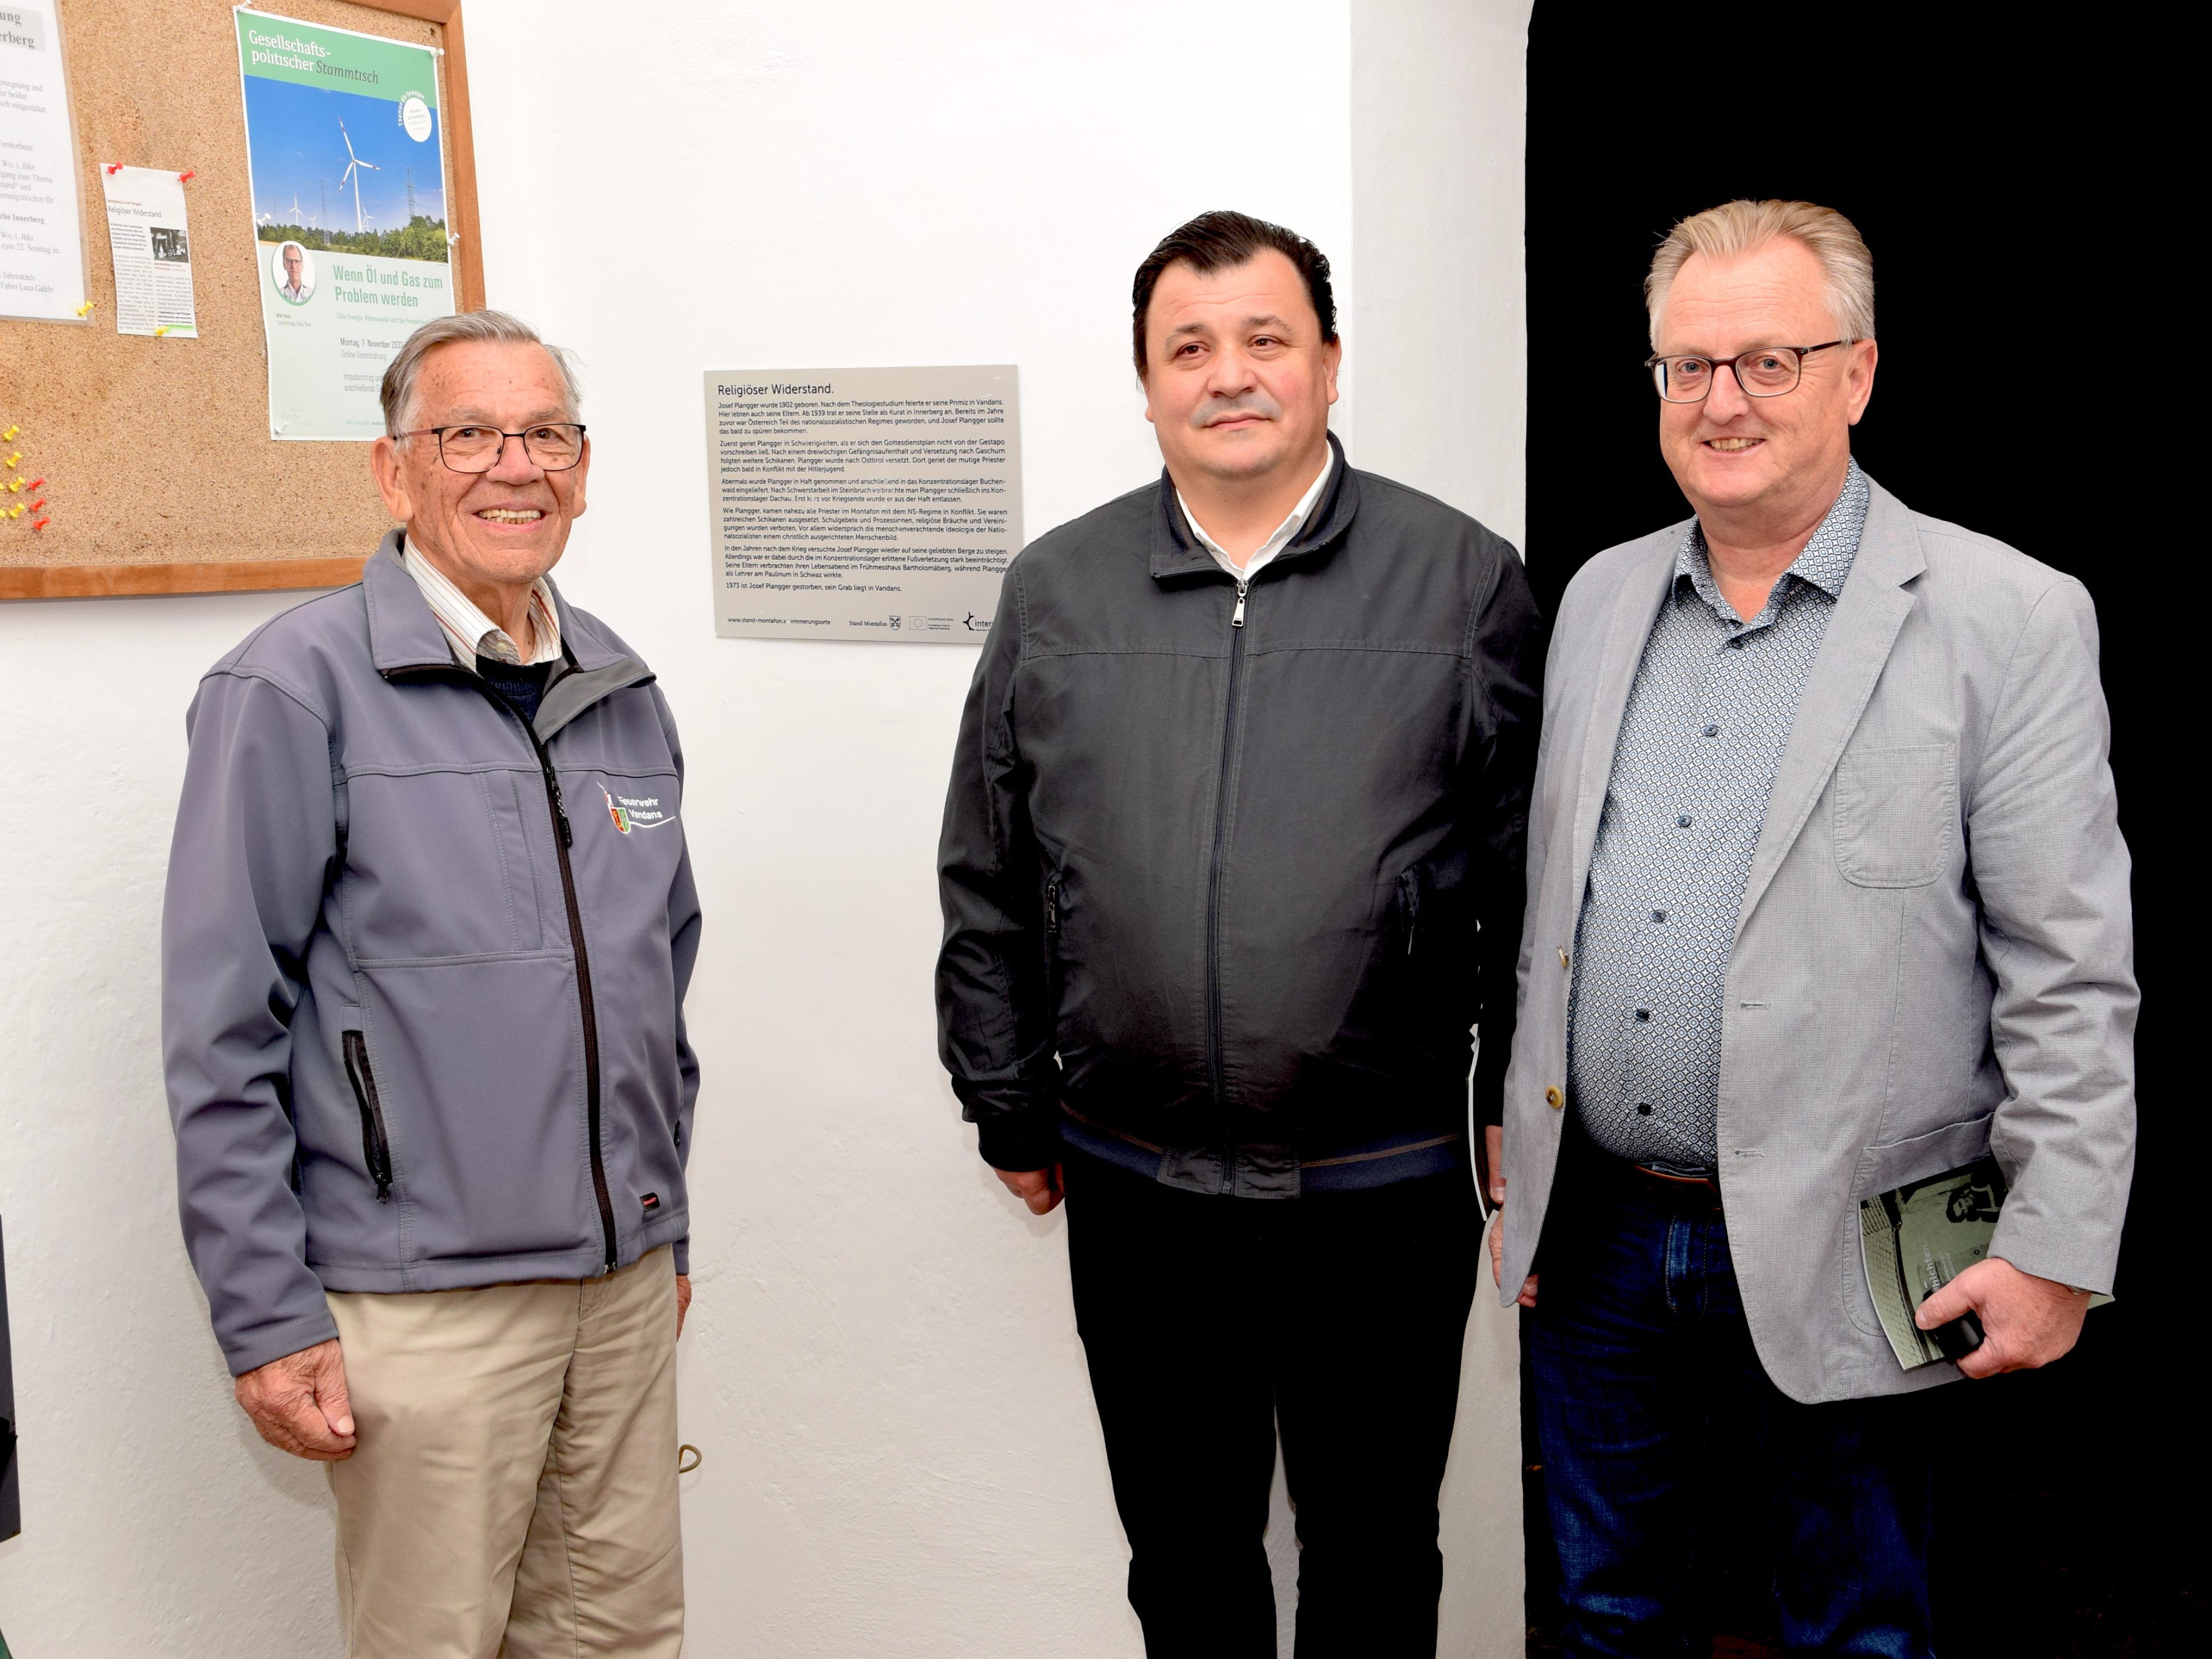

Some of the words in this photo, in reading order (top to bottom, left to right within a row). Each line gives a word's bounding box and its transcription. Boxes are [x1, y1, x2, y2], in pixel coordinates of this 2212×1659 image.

[249, 30, 331, 58] Gesellschafts-
[316, 60, 379, 84] Stammtisch
[32, 174, 53, 183] Thema
[108, 206, 132, 215] Religiöser
[132, 208, 162, 218] Widerstand
[13, 214, 45, 224] Innerberg
[27, 244, 51, 255] Sonntag
[3, 272, 36, 281] Jahreskreis
[333, 265, 363, 282] Wenn
[367, 265, 378, 283] Öl
[381, 268, 398, 286] und
[402, 271, 420, 288] Gas
[423, 277, 443, 289] zum
[1, 282, 18, 290] Fabio
[19, 283, 34, 291] Luca
[335, 286, 378, 304] Problem
[381, 291, 418, 307] werden
[341, 338, 361, 348] Montag,
[367, 339, 390, 348] November
[718, 384, 768, 398] Religiöser
[771, 383, 834, 395] Widerstand.
[851, 400, 904, 409] Theologiestudium
[868, 418, 894, 426] Regimes
[894, 417, 926, 426] geworden,
[959, 416, 986, 425] Plangger
[807, 448, 847, 456] dreiwöchigen
[849, 448, 909, 456] Gefängnisaufenthalt
[923, 447, 958, 456] Versetzung
[765, 583, 792, 591] Plangger
[727, 617, 831, 626] www.stand-montafon.aerinnerungsorte
[628, 809, 663, 819] Vandans
